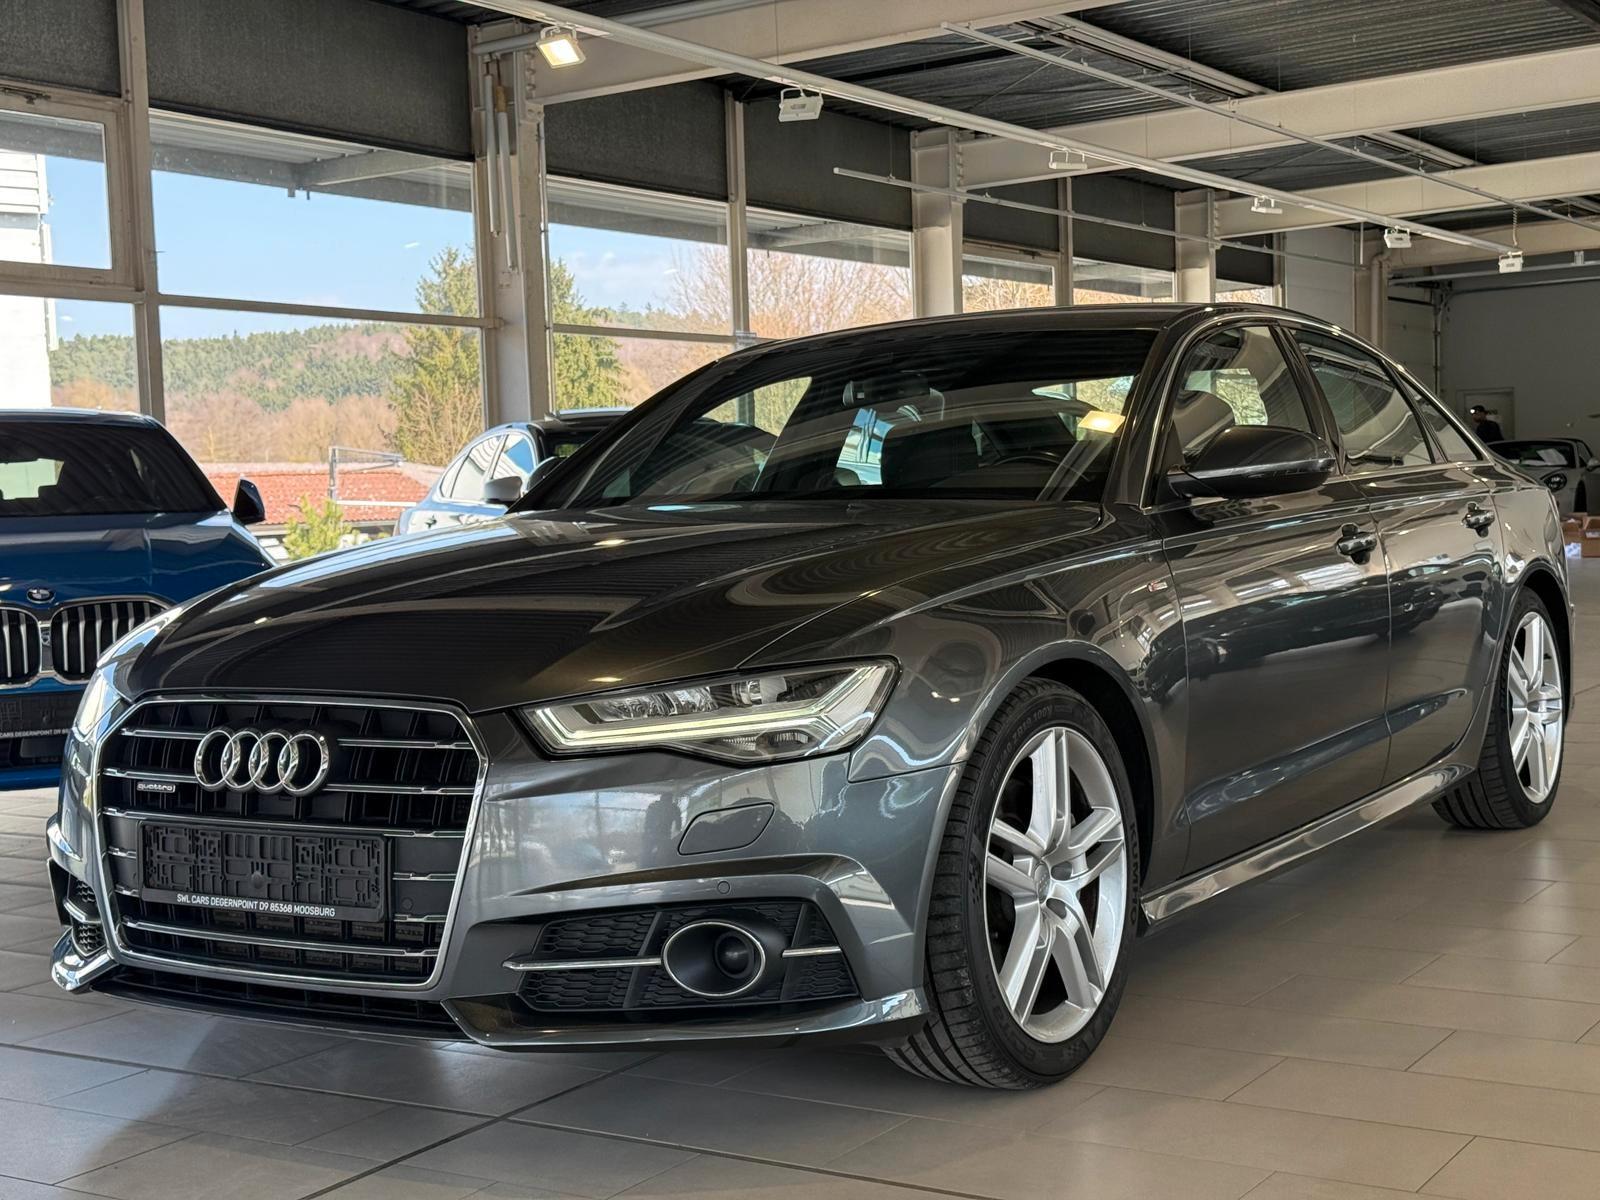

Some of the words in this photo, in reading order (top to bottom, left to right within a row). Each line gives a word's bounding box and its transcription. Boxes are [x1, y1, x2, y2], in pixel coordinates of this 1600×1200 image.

[137, 783, 174, 792] quattro
[1129, 822, 1139, 925] KUMHO
[177, 893, 191, 904] SWL
[191, 895, 210, 906] CARS
[210, 897, 258, 910] DEGERNPOINT
[259, 902, 269, 911] D9
[270, 903, 293, 914] 85368
[293, 905, 336, 917] MOOSBURG
